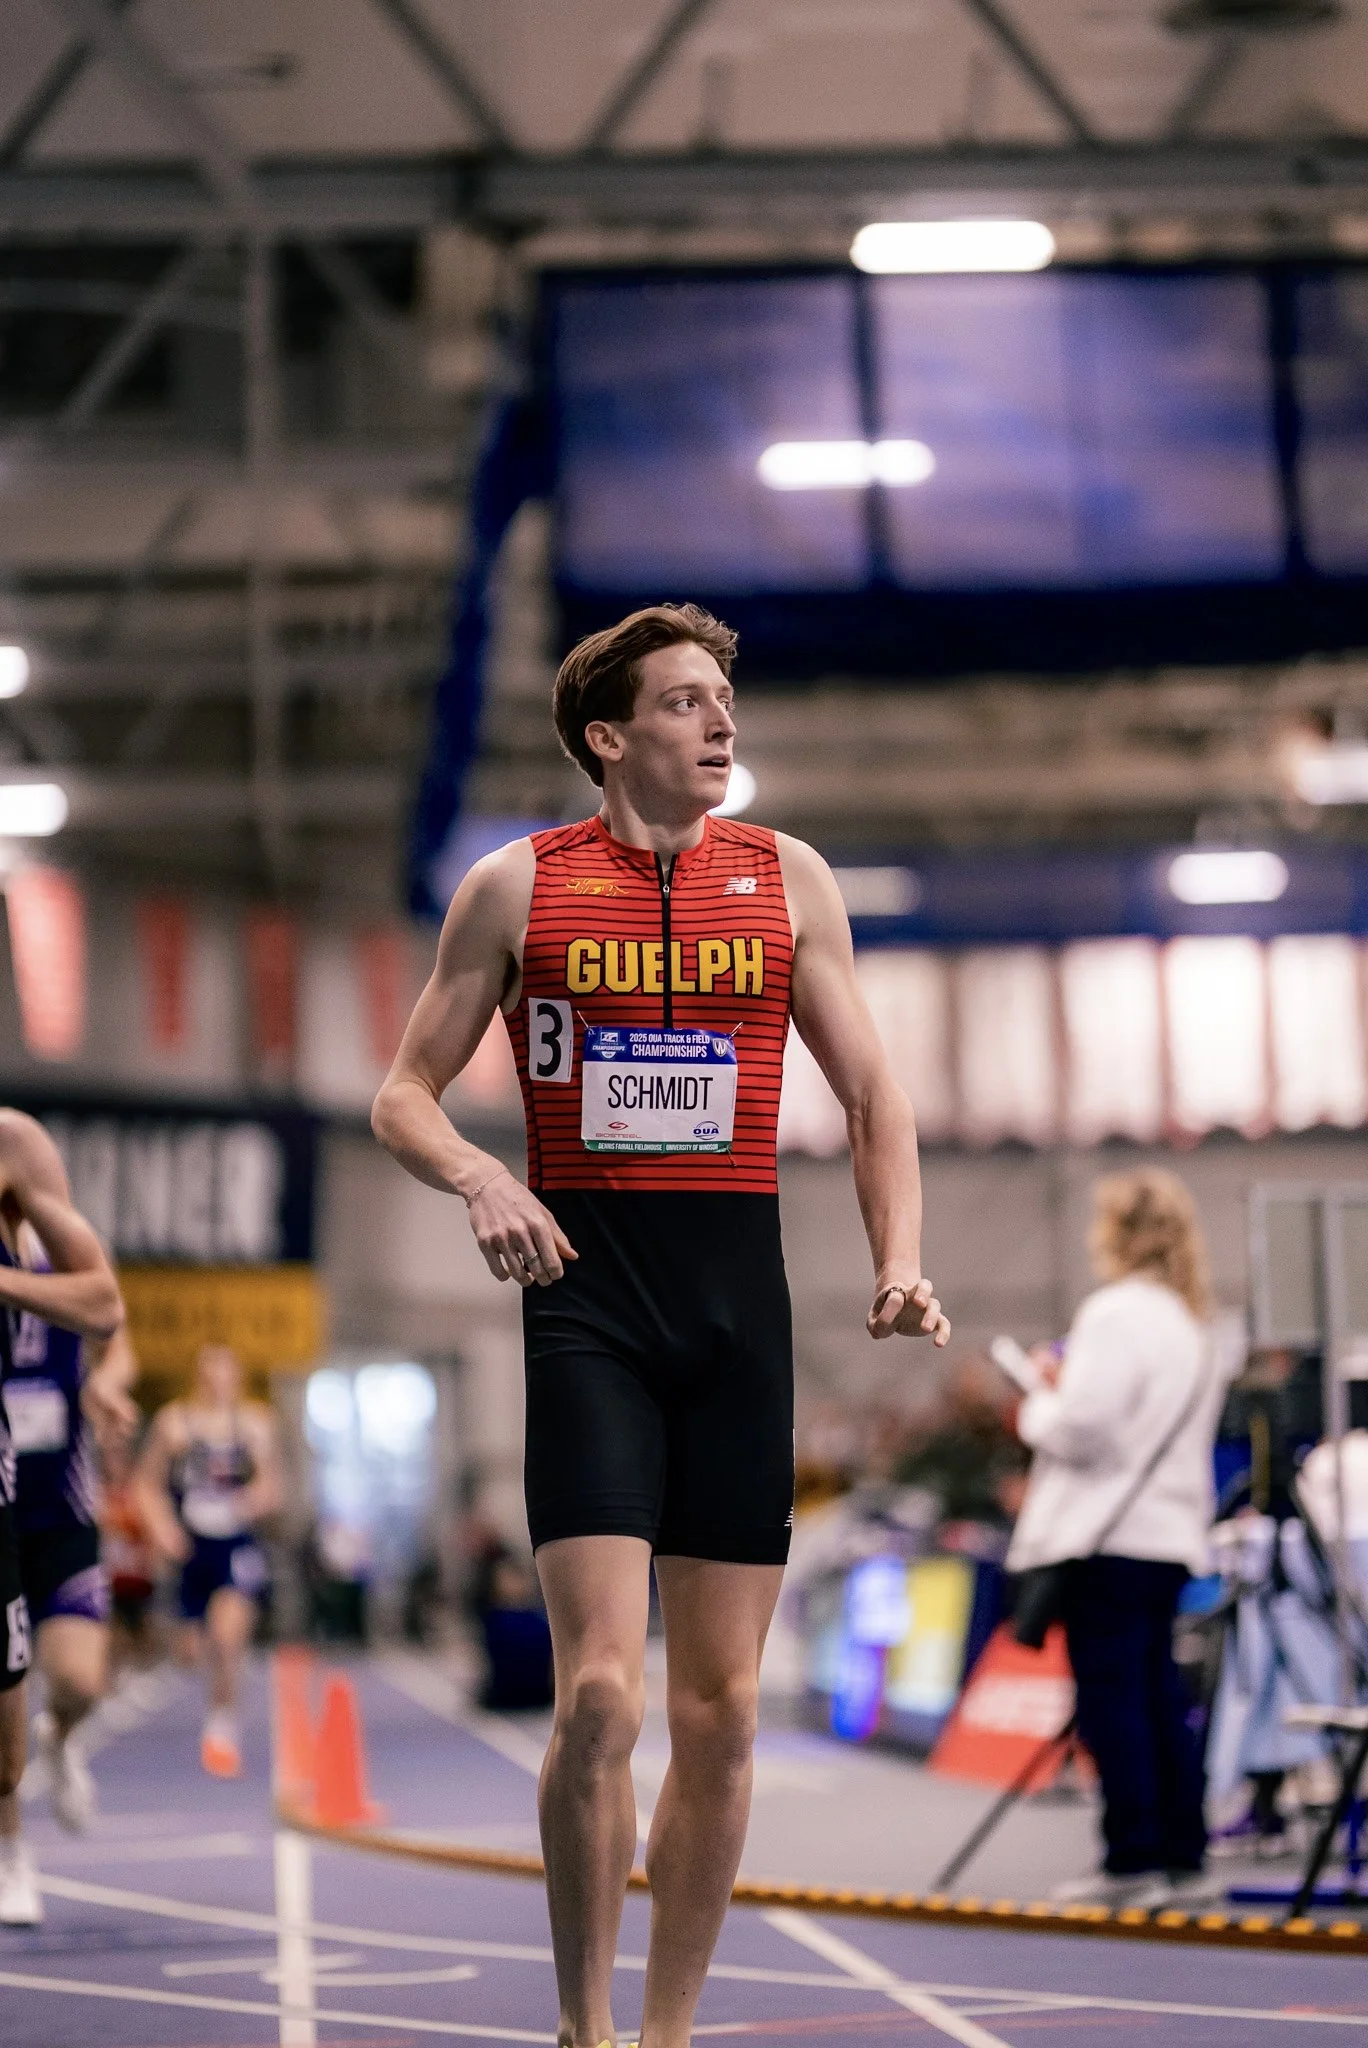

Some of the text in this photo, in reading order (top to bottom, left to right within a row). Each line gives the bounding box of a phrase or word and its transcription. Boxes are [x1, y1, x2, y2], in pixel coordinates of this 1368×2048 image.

[566, 937, 765, 996] GUELPH
[536, 1002, 563, 1077] 3
[629, 1033, 647, 1042] 2025
[648, 1034, 662, 1043] OUA
[664, 1034, 685, 1044] TRACK
[692, 1035, 710, 1045] FIELD
[632, 1044, 707, 1058] CHAMPIONSHIPS
[607, 1074, 714, 1110] SCHMIDT
